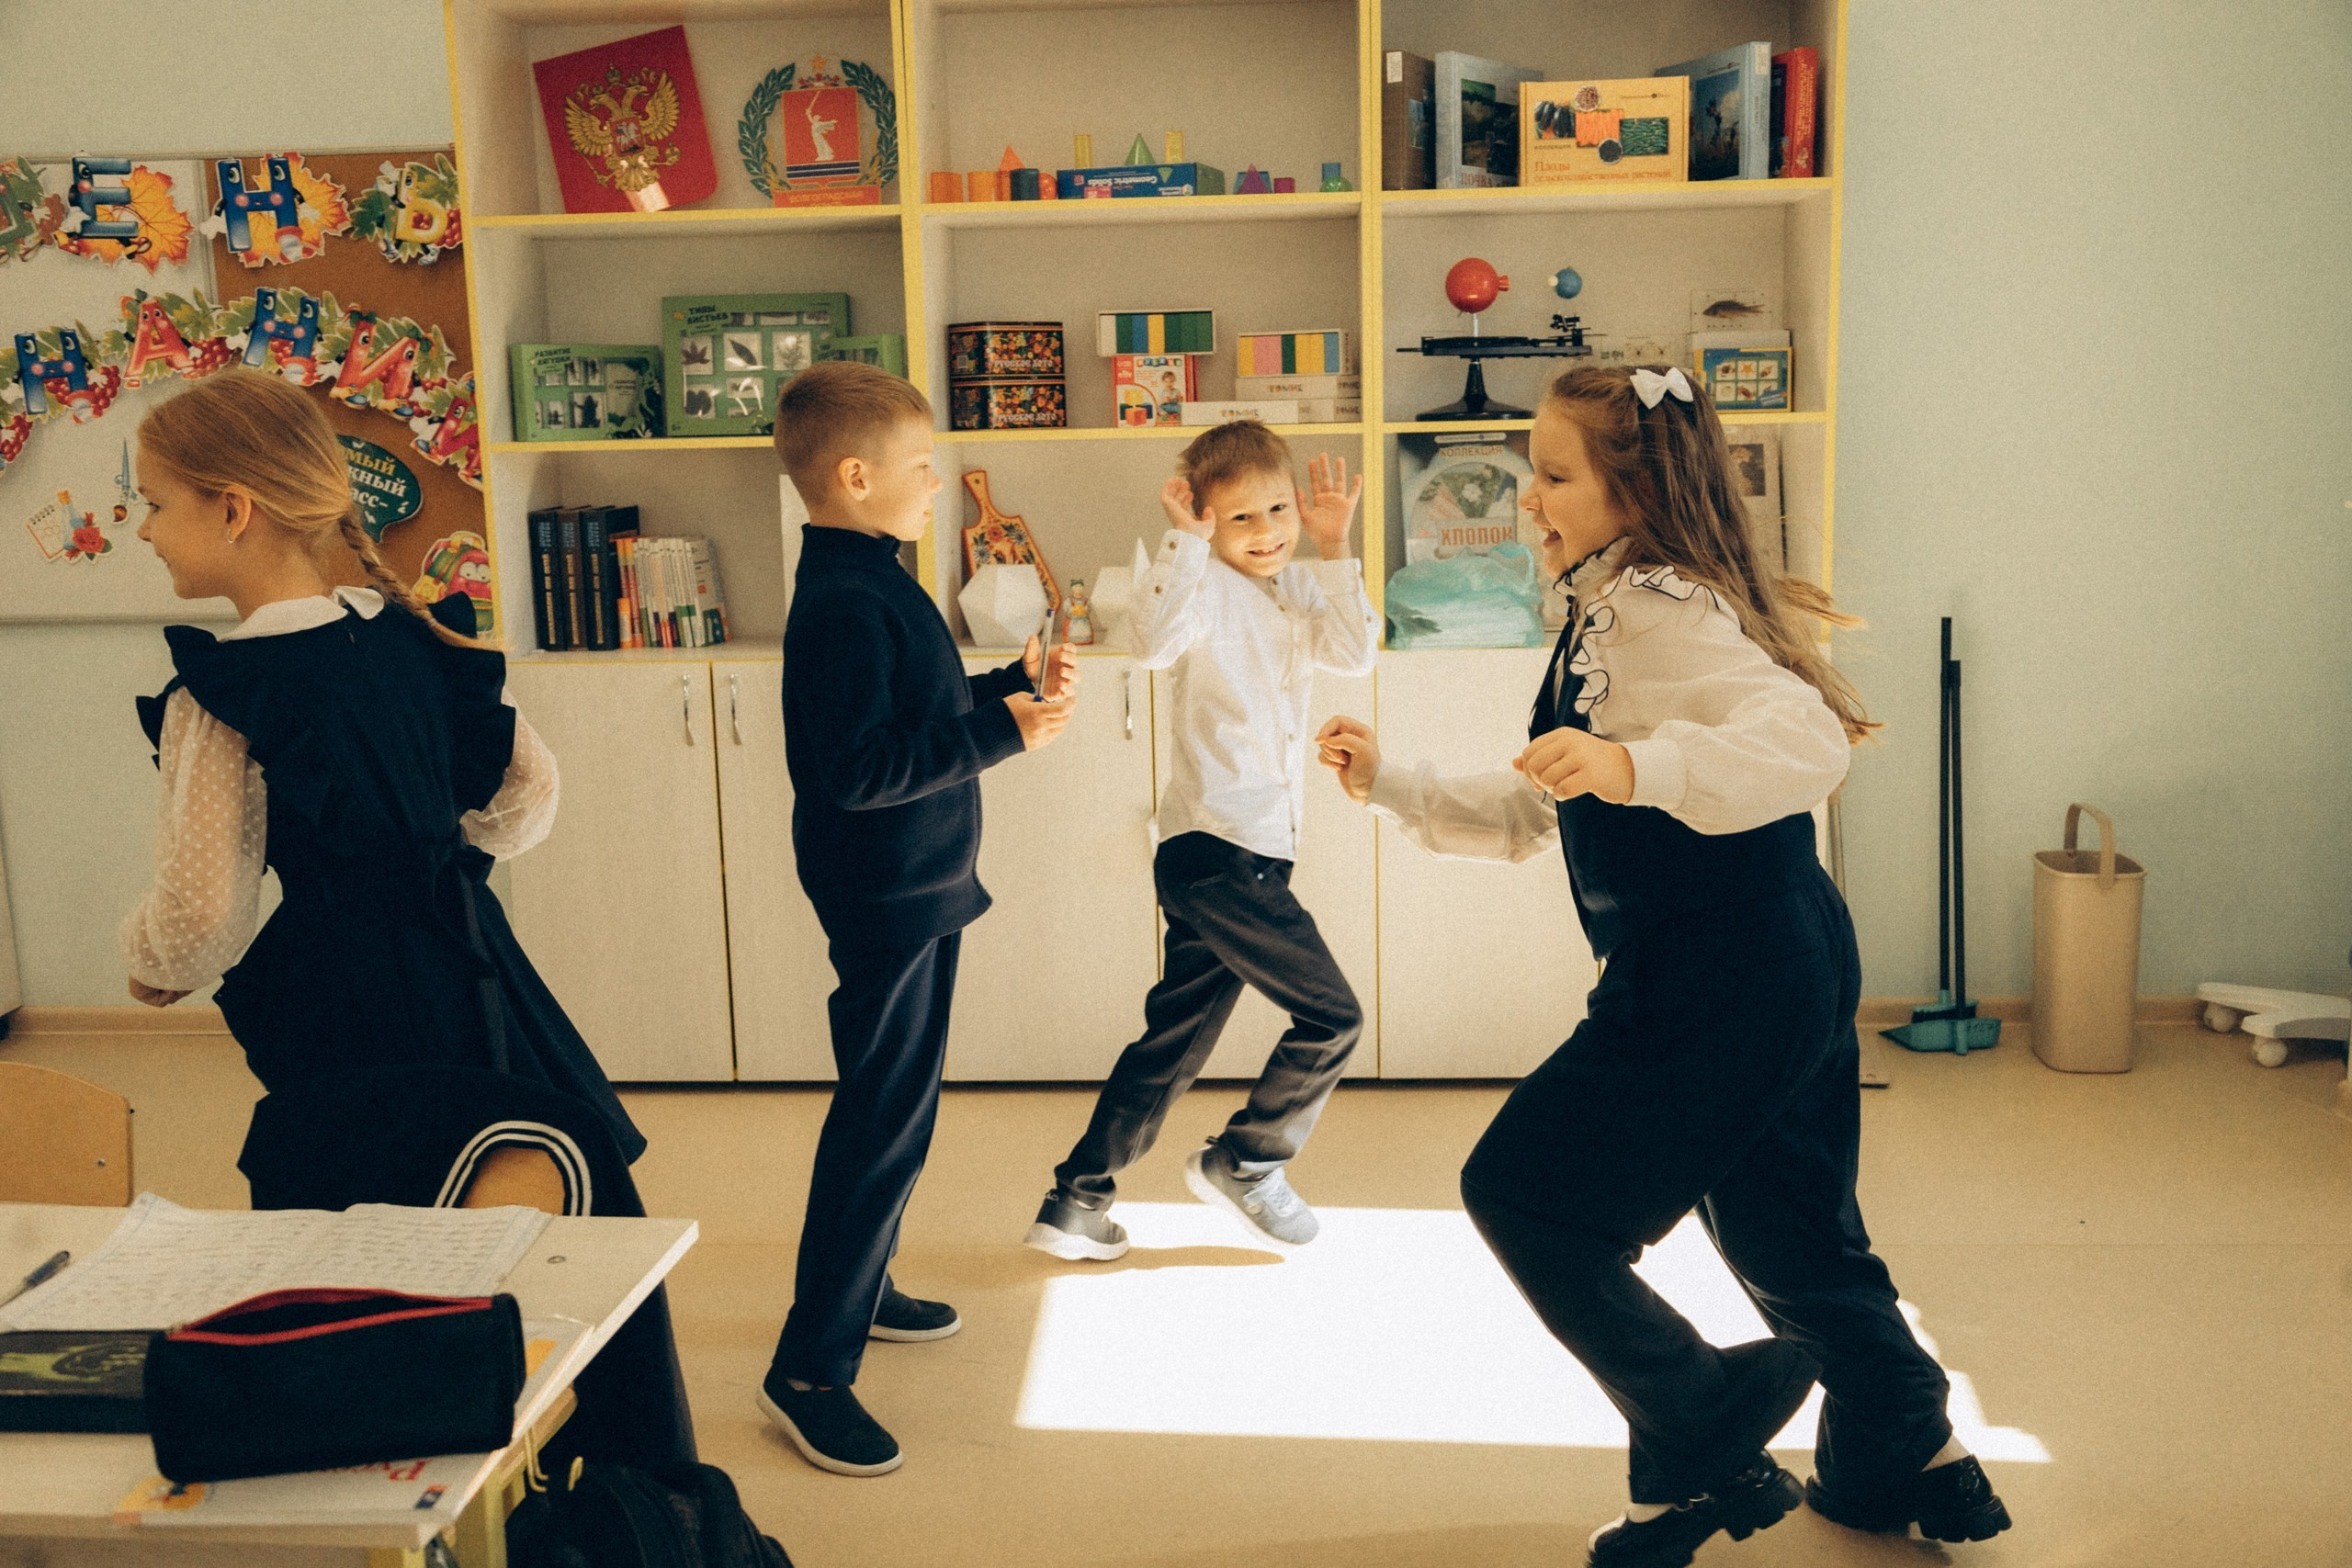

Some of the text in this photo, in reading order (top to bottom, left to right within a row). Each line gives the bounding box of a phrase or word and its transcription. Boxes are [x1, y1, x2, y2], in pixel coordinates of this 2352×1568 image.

[1088, 175, 1158, 186] Geometric Solids
[1440, 446, 1502, 457] КОЛЛЕКЦИЯ
[346, 448, 397, 476] мый
[350, 488, 389, 508] асс-
[1441, 526, 1513, 546] ХЛОПОК
